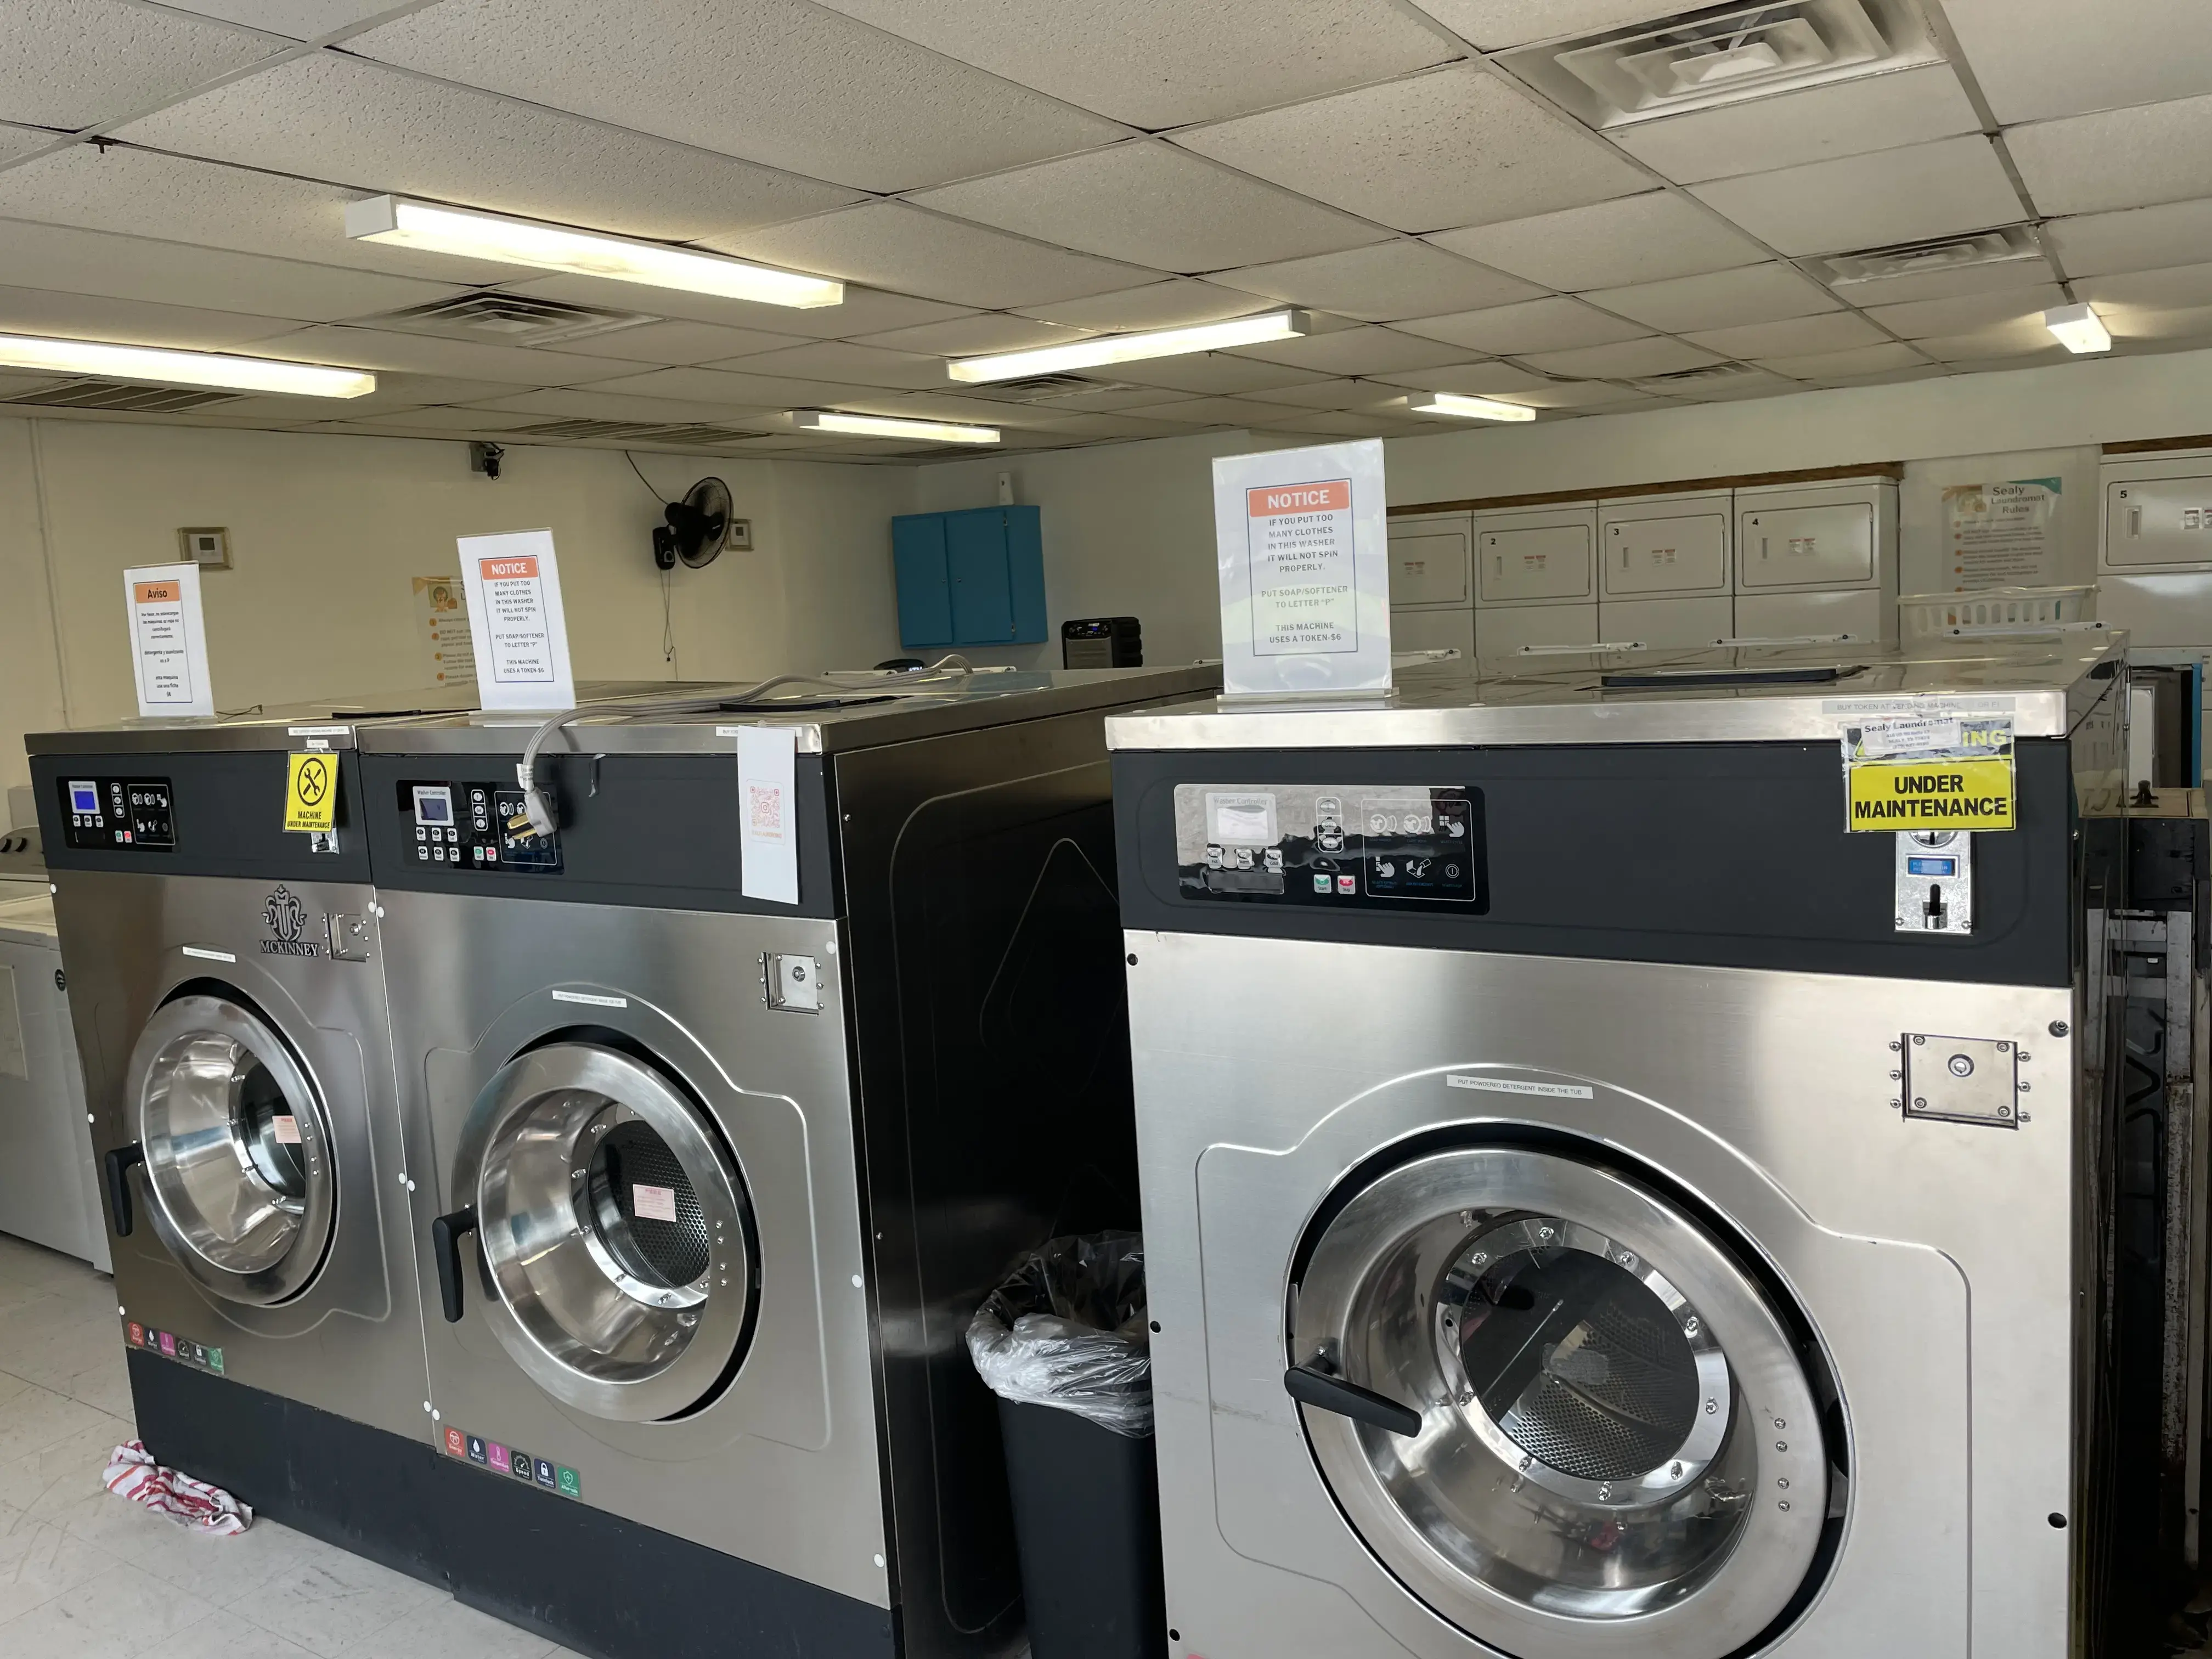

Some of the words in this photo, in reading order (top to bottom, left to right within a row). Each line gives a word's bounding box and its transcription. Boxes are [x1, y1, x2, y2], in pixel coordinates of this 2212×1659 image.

[1993, 485, 2025, 496] Sealy
[2120, 490, 2127, 498] 5
[1268, 490, 1330, 509] NOTICE
[1991, 494, 2045, 504] Laundromat
[2002, 506, 2030, 514] Rules
[1269, 530, 1293, 538] MANY
[1295, 527, 1333, 536] CLOTHES
[1299, 539, 1335, 548] WASHER
[492, 562, 527, 575] NOTICE
[1280, 563, 1325, 572] PROPERLY.
[148, 588, 167, 599] Aviso
[1279, 586, 1347, 596] SOAP/SOFTENER
[1288, 599, 1319, 607] LETTER
[1301, 634, 1341, 642] TOKEN-$6
[1865, 724, 1891, 732] Sealy
[1893, 717, 1953, 729] Laundromat
[1894, 774, 1964, 794] UNDER
[1855, 797, 2007, 819] MAINTENANCE
[297, 811, 321, 820] MACHINE
[260, 940, 318, 957] MCKINNEY
[1503, 1083, 1536, 1091] DETERGENT
[516, 1468, 529, 1476] Speed
